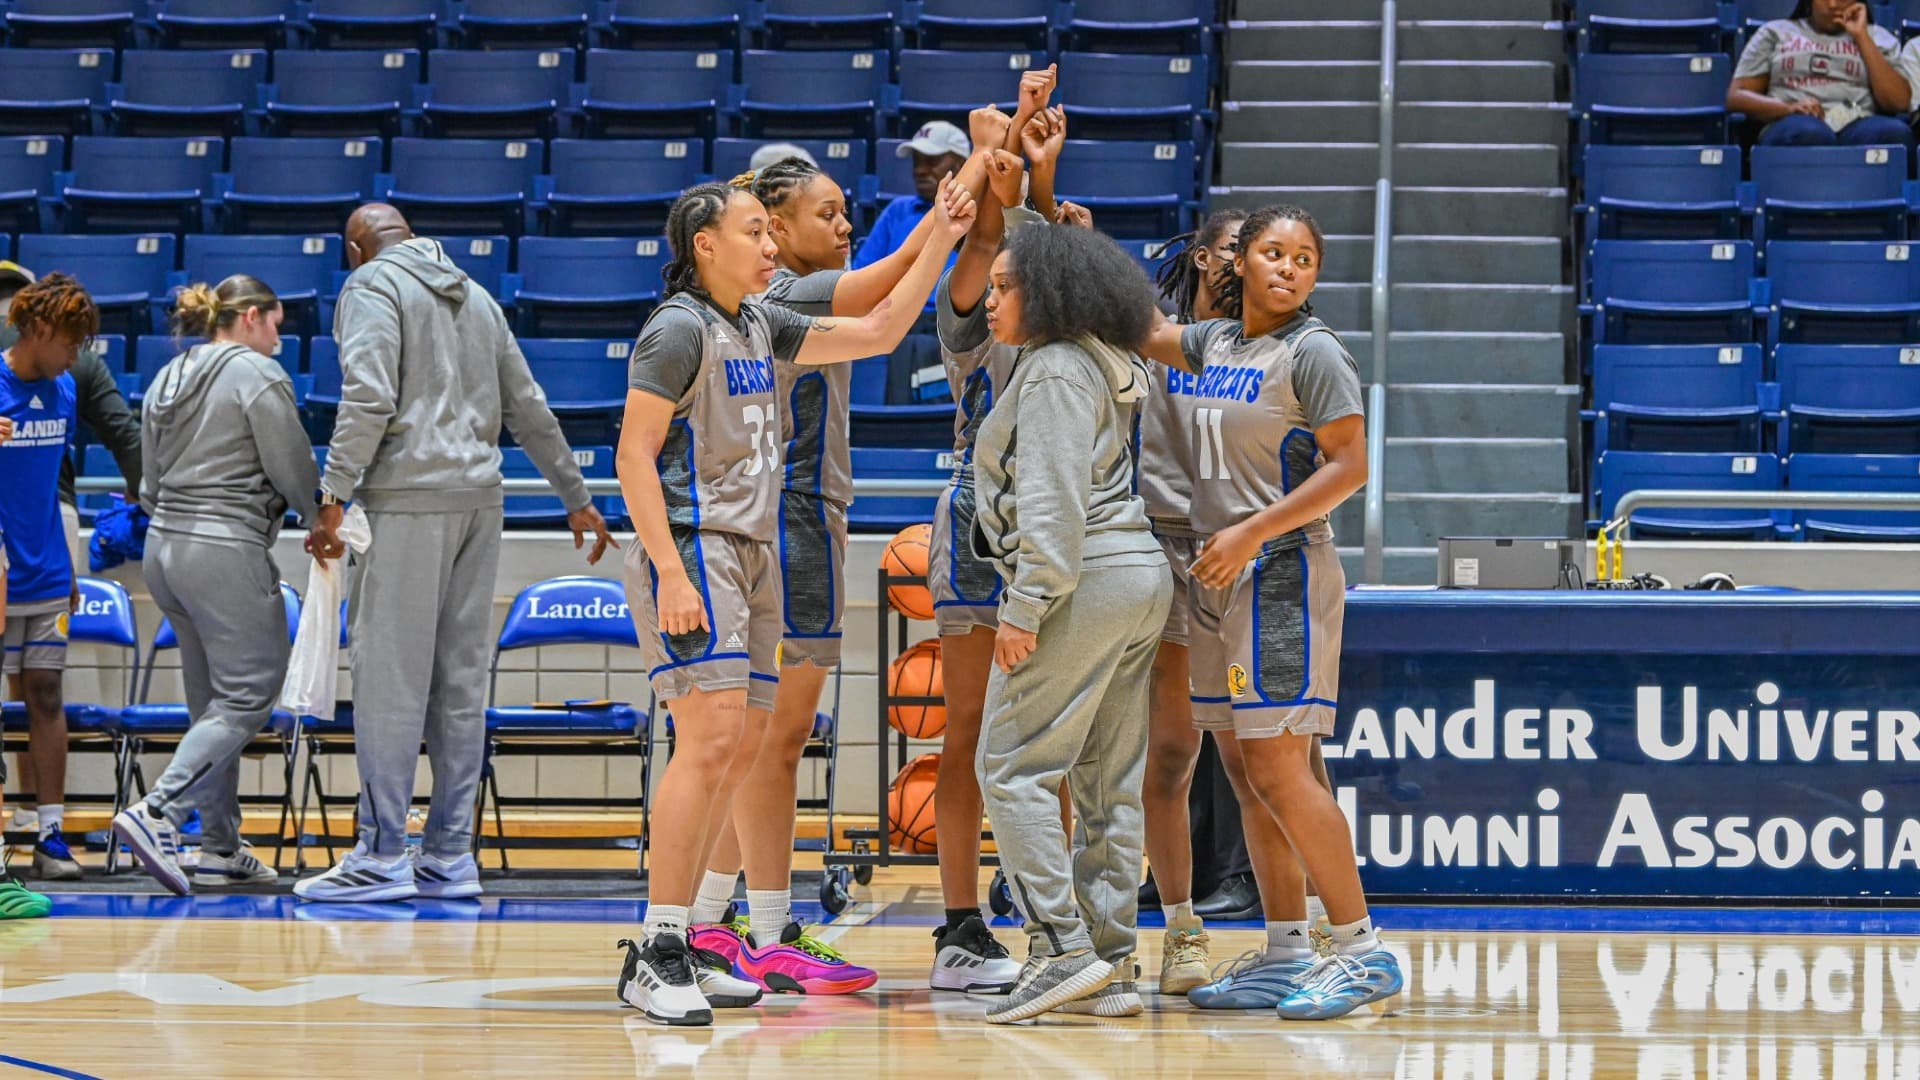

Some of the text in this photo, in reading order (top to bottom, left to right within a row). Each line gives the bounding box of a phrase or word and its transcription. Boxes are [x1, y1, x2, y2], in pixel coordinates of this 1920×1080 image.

[1160, 146, 1171, 157] 14
[1197, 408, 1232, 480] 11
[527, 597, 629, 619] Lander
[1320, 679, 1598, 760] ANdER
